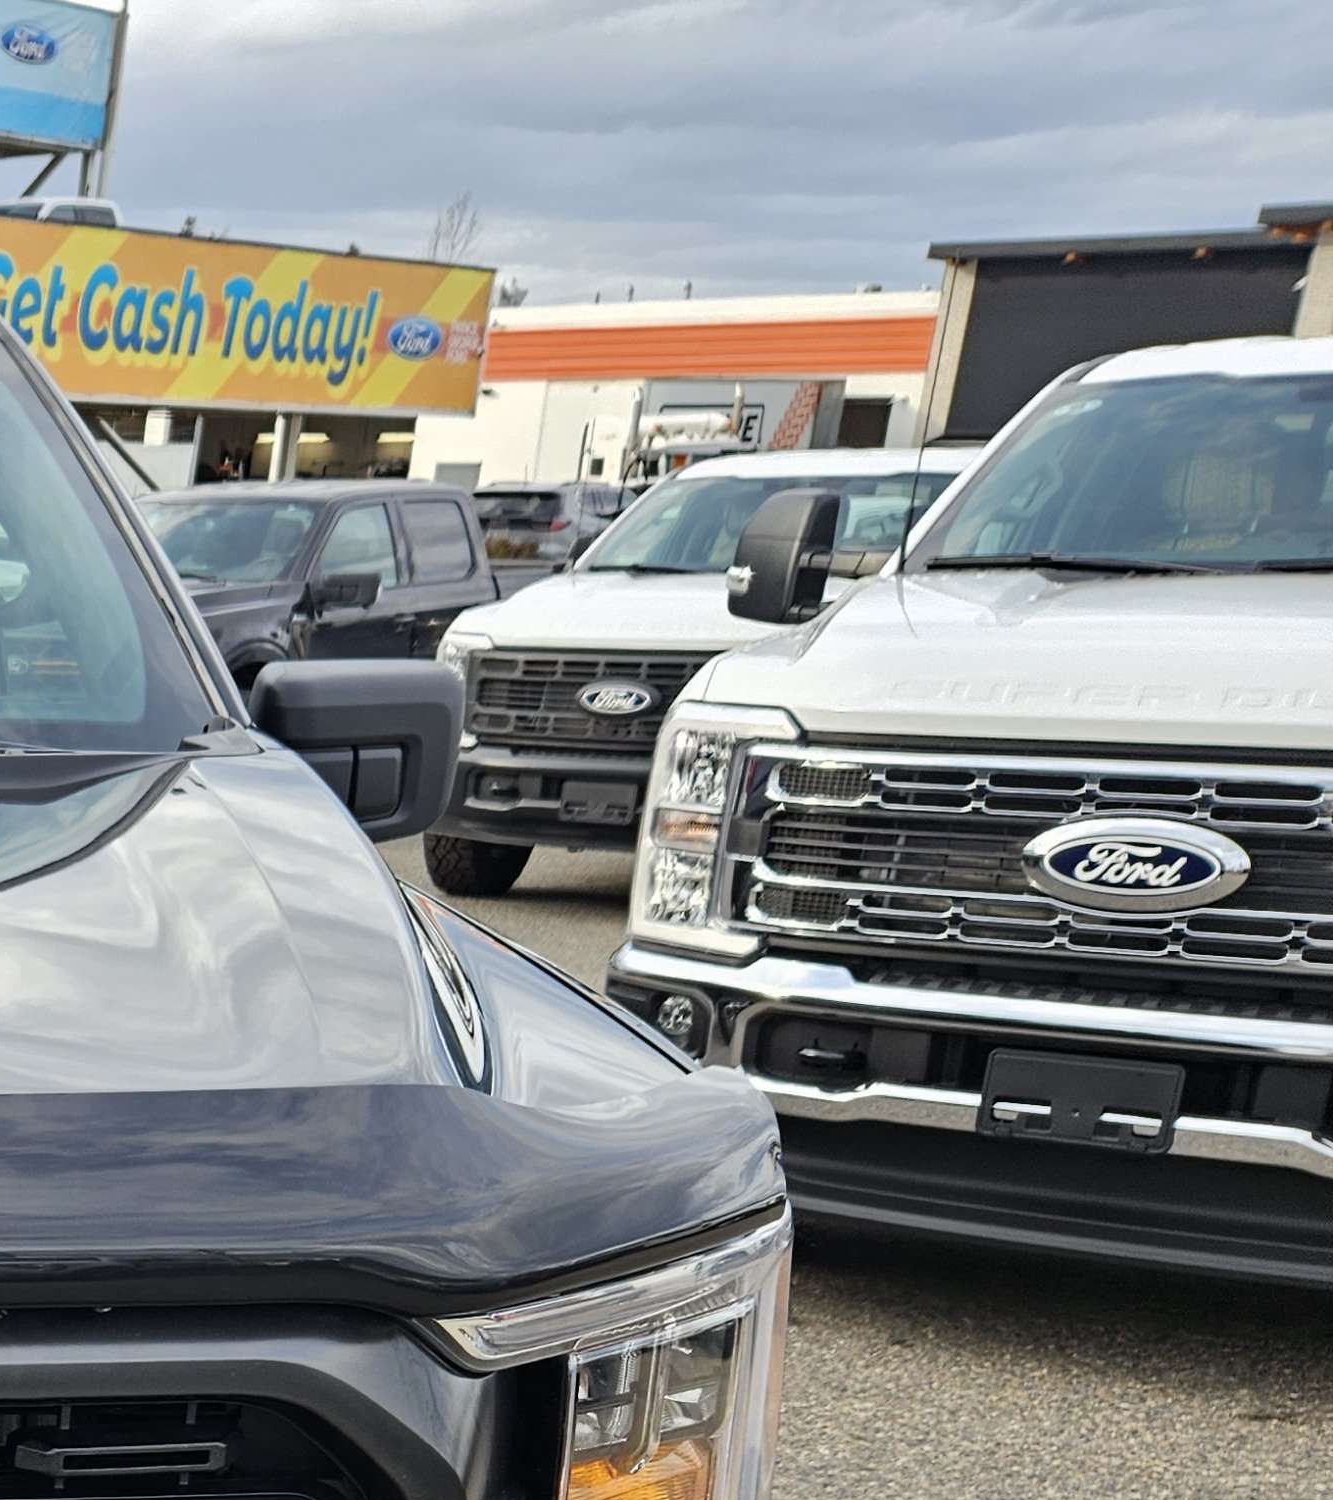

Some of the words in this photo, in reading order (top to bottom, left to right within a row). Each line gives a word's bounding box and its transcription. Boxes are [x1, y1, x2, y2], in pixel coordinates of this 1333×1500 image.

[79, 264, 205, 357] Cash
[221, 277, 381, 387] Today!
[1074, 842, 1188, 887] Ford
